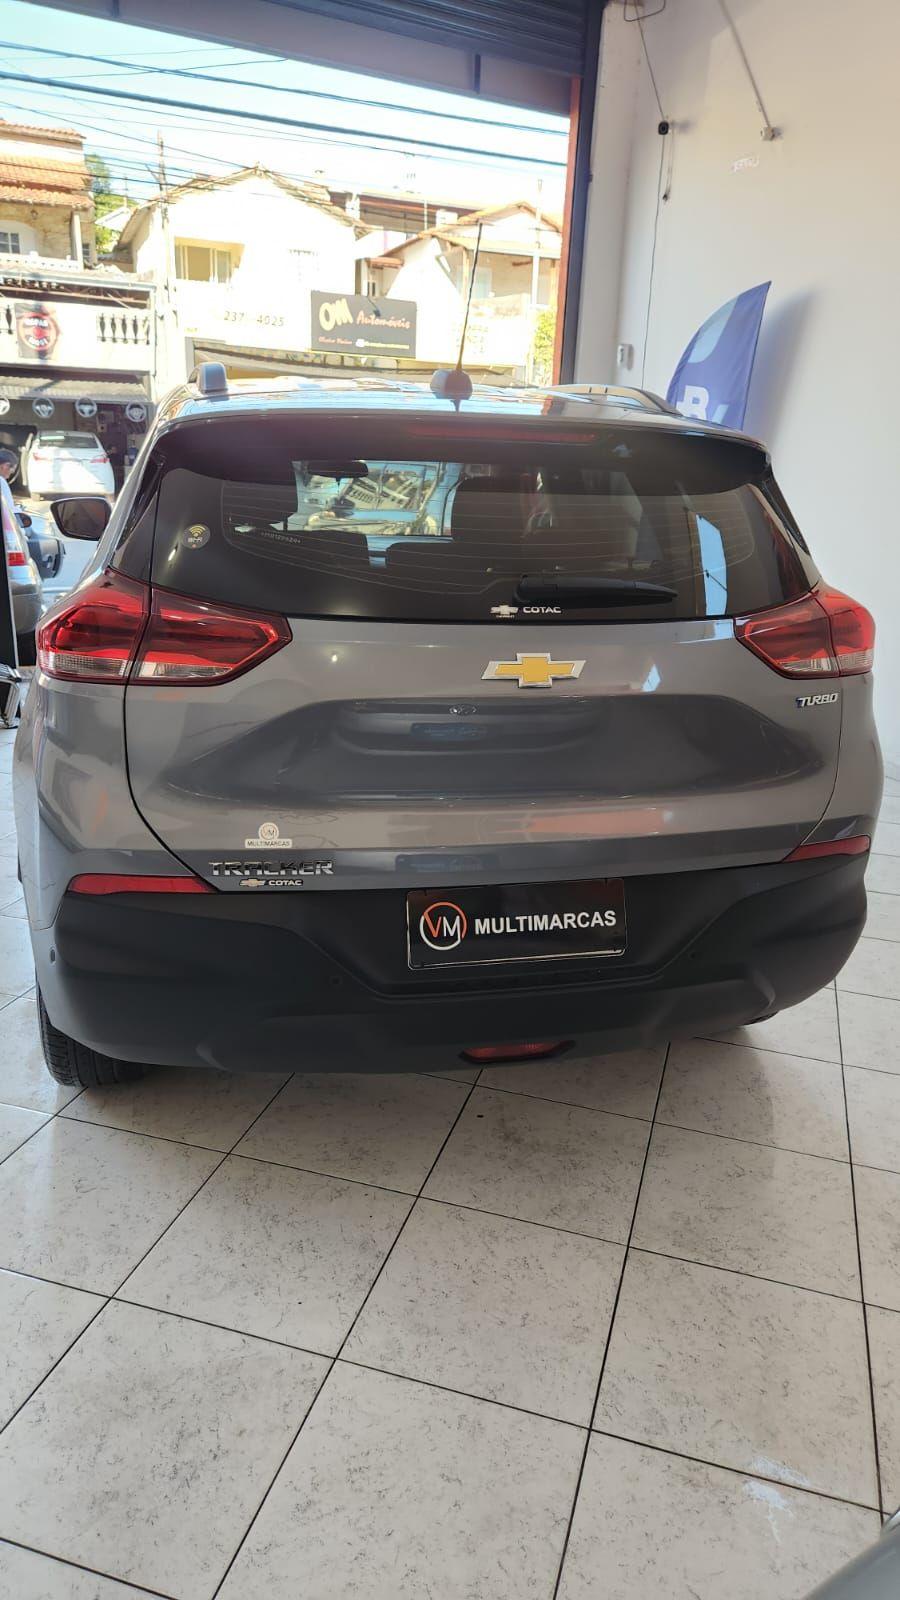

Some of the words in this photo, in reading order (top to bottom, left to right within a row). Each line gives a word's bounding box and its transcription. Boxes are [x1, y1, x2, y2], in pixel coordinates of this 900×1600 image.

[319, 298, 353, 331] OM
[522, 606, 562, 614] COTAC
[796, 693, 839, 708] TURBO
[246, 840, 291, 848] MULTIMARCAS
[208, 860, 334, 876] TRACKER
[268, 879, 303, 887] COTAC
[474, 910, 617, 935] MULTIMARCAS
